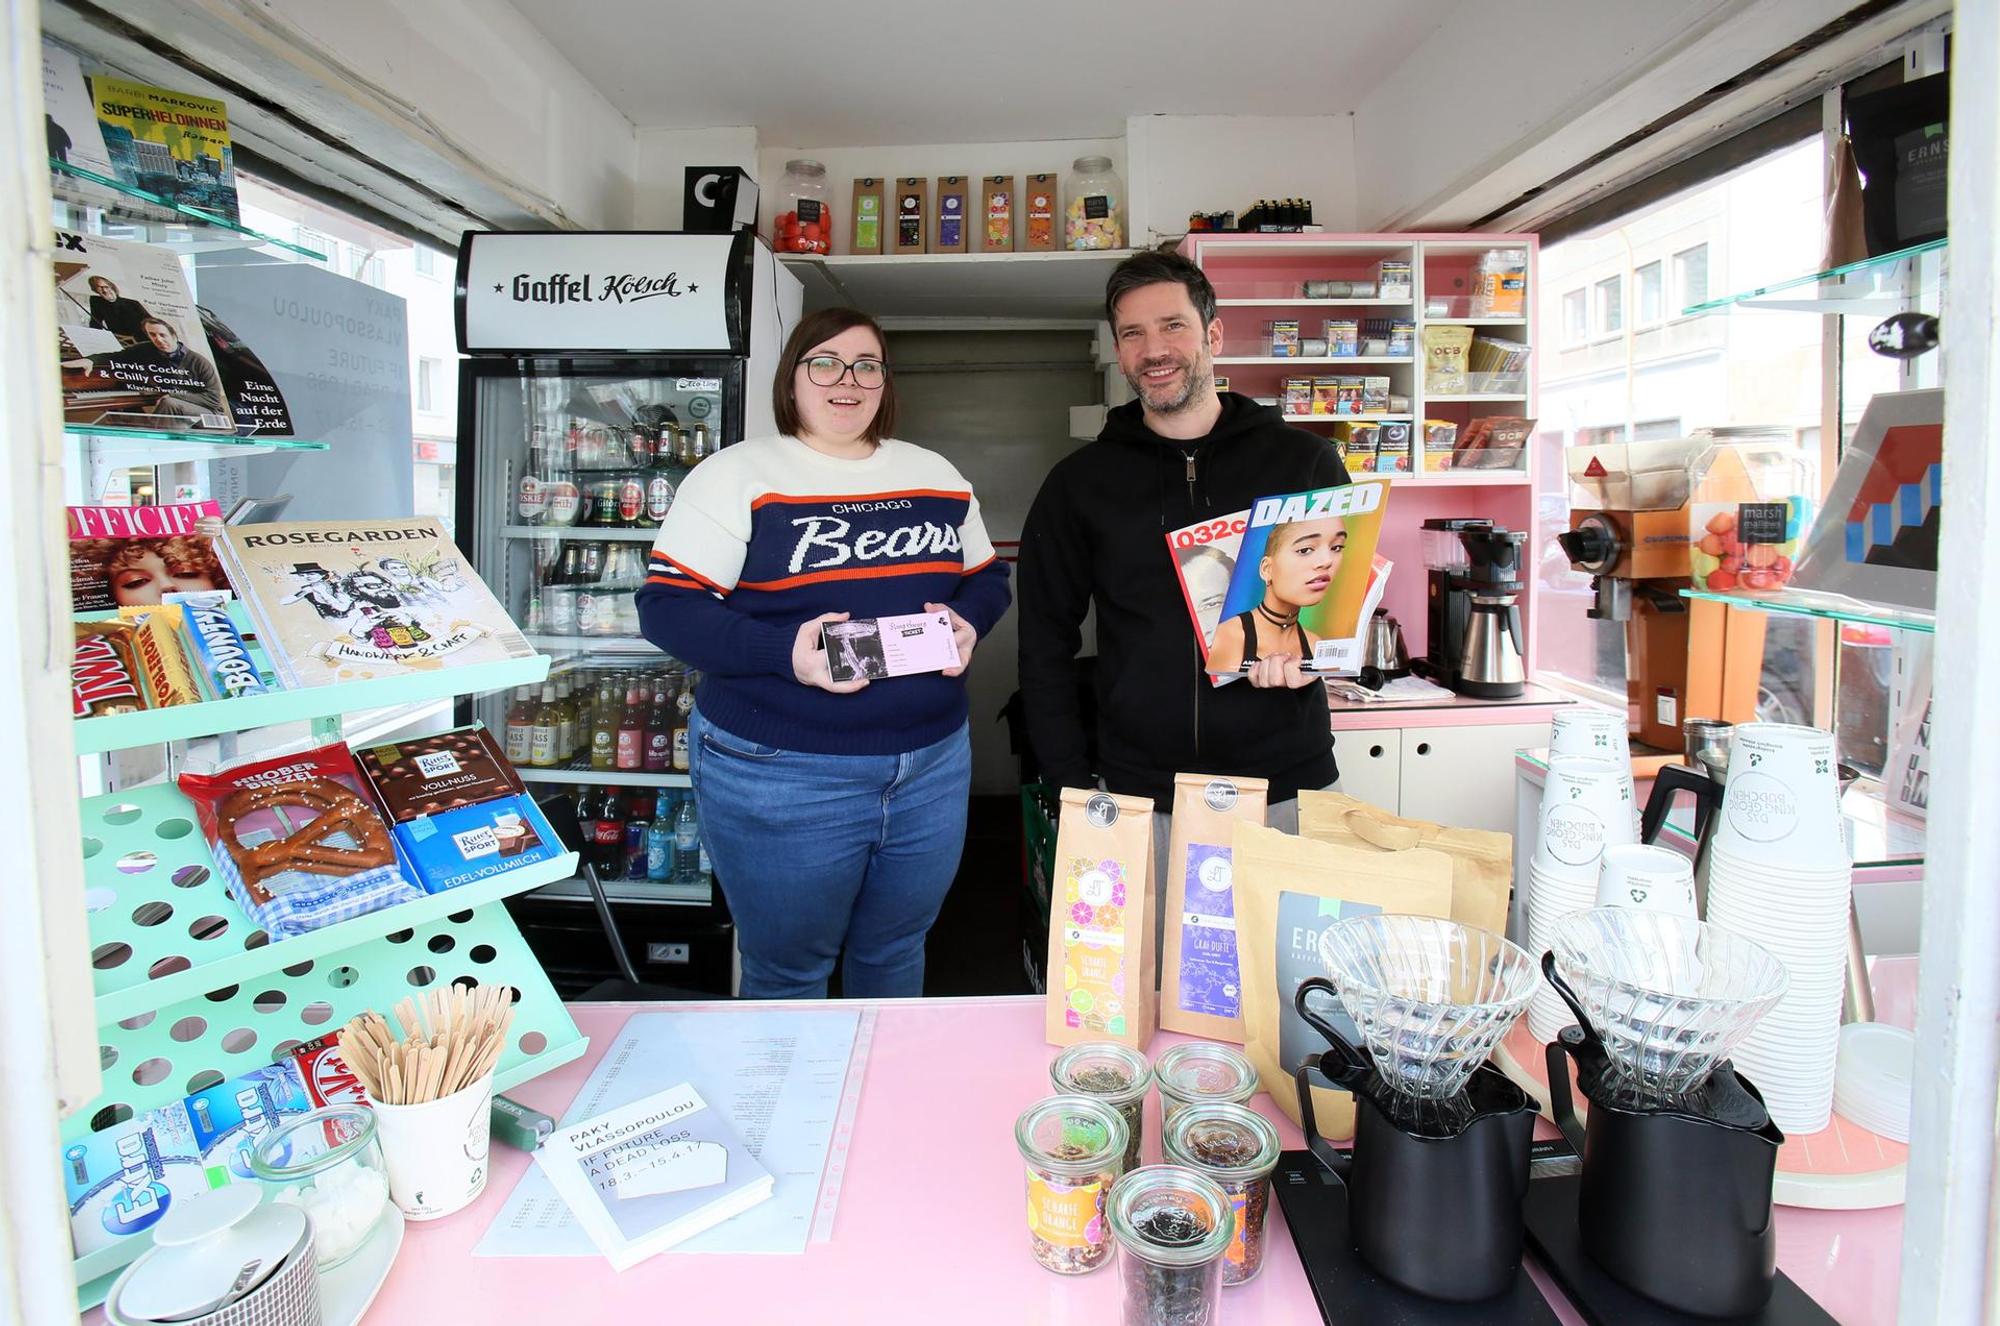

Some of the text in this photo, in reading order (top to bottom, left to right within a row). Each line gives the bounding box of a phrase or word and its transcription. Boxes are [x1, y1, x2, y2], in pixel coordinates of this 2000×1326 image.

[102, 101, 228, 132] SUPERHELDINNEN
[512, 272, 682, 305] Gaffel Kölsch
[1434, 346, 1461, 356] OCB
[110, 360, 190, 376] Jarvis Cocker
[100, 369, 206, 388] & Chilly Gonzales
[244, 381, 275, 392] Eine
[240, 392, 280, 404] Nacht
[236, 405, 284, 416] auf der
[256, 418, 287, 429] Erde
[1498, 432, 1524, 441] OCB
[831, 499, 913, 514] CHICAGO
[1251, 482, 1384, 529] DAZED
[1744, 507, 1782, 519] marsh
[244, 527, 438, 548] ROSEGARDEN
[788, 515, 962, 574] Bears
[1176, 519, 1247, 550] 032c
[192, 606, 260, 692] BOUNTY
[72, 634, 138, 719] TWIX
[418, 752, 452, 768] Ritter
[424, 761, 455, 774] SPORT
[232, 761, 319, 788] HUOBER
[421, 773, 478, 792] VOLL-NUSS
[458, 830, 491, 847] Ritter
[464, 839, 497, 854] SPORT
[444, 852, 542, 888] EDEL-VOLLMILCH
[569, 1122, 612, 1143] PAKY
[575, 1100, 695, 1153] VLASSOPOULOU
[583, 1129, 665, 1167] IF FUTURE
[590, 1130, 692, 1177] A DEAD LOSS
[116, 1131, 161, 1225] Extra
